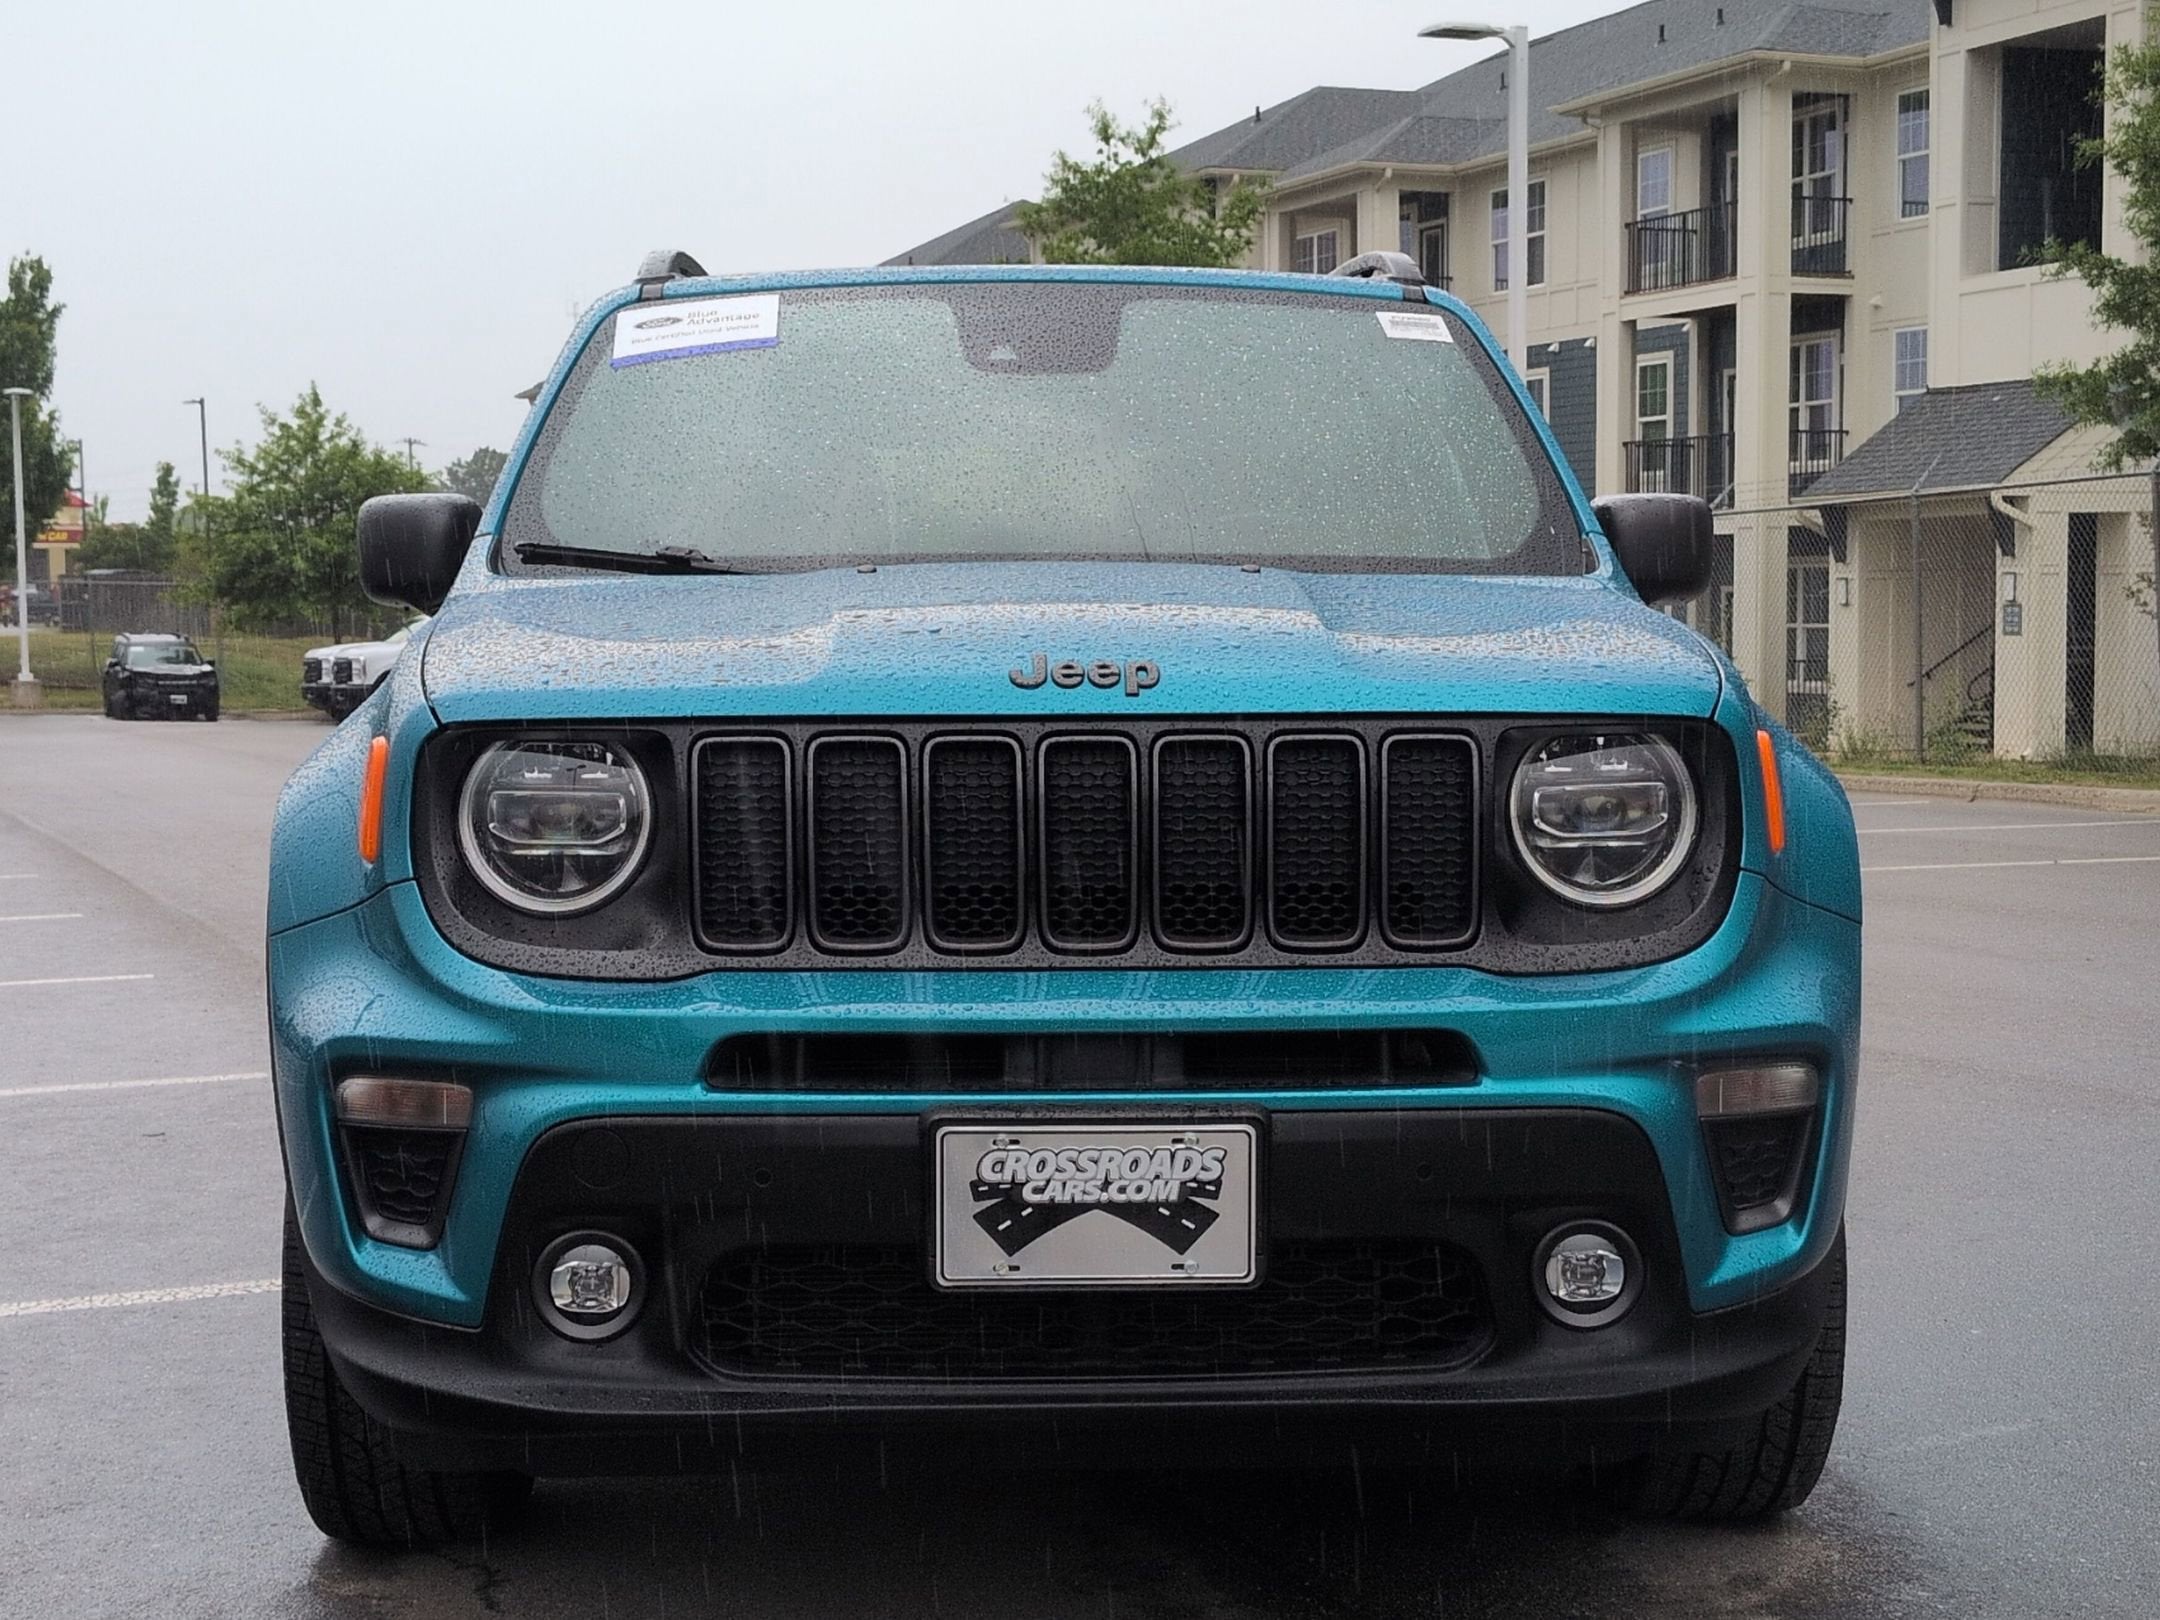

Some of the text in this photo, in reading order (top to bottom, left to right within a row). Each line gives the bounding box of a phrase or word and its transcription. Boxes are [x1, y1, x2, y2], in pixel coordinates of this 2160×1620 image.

[686, 312, 760, 326] Advantage
[1009, 651, 1160, 697] Jeep
[976, 1147, 1227, 1183] CROSSROADS
[1021, 1178, 1181, 1203] CARS.COM
